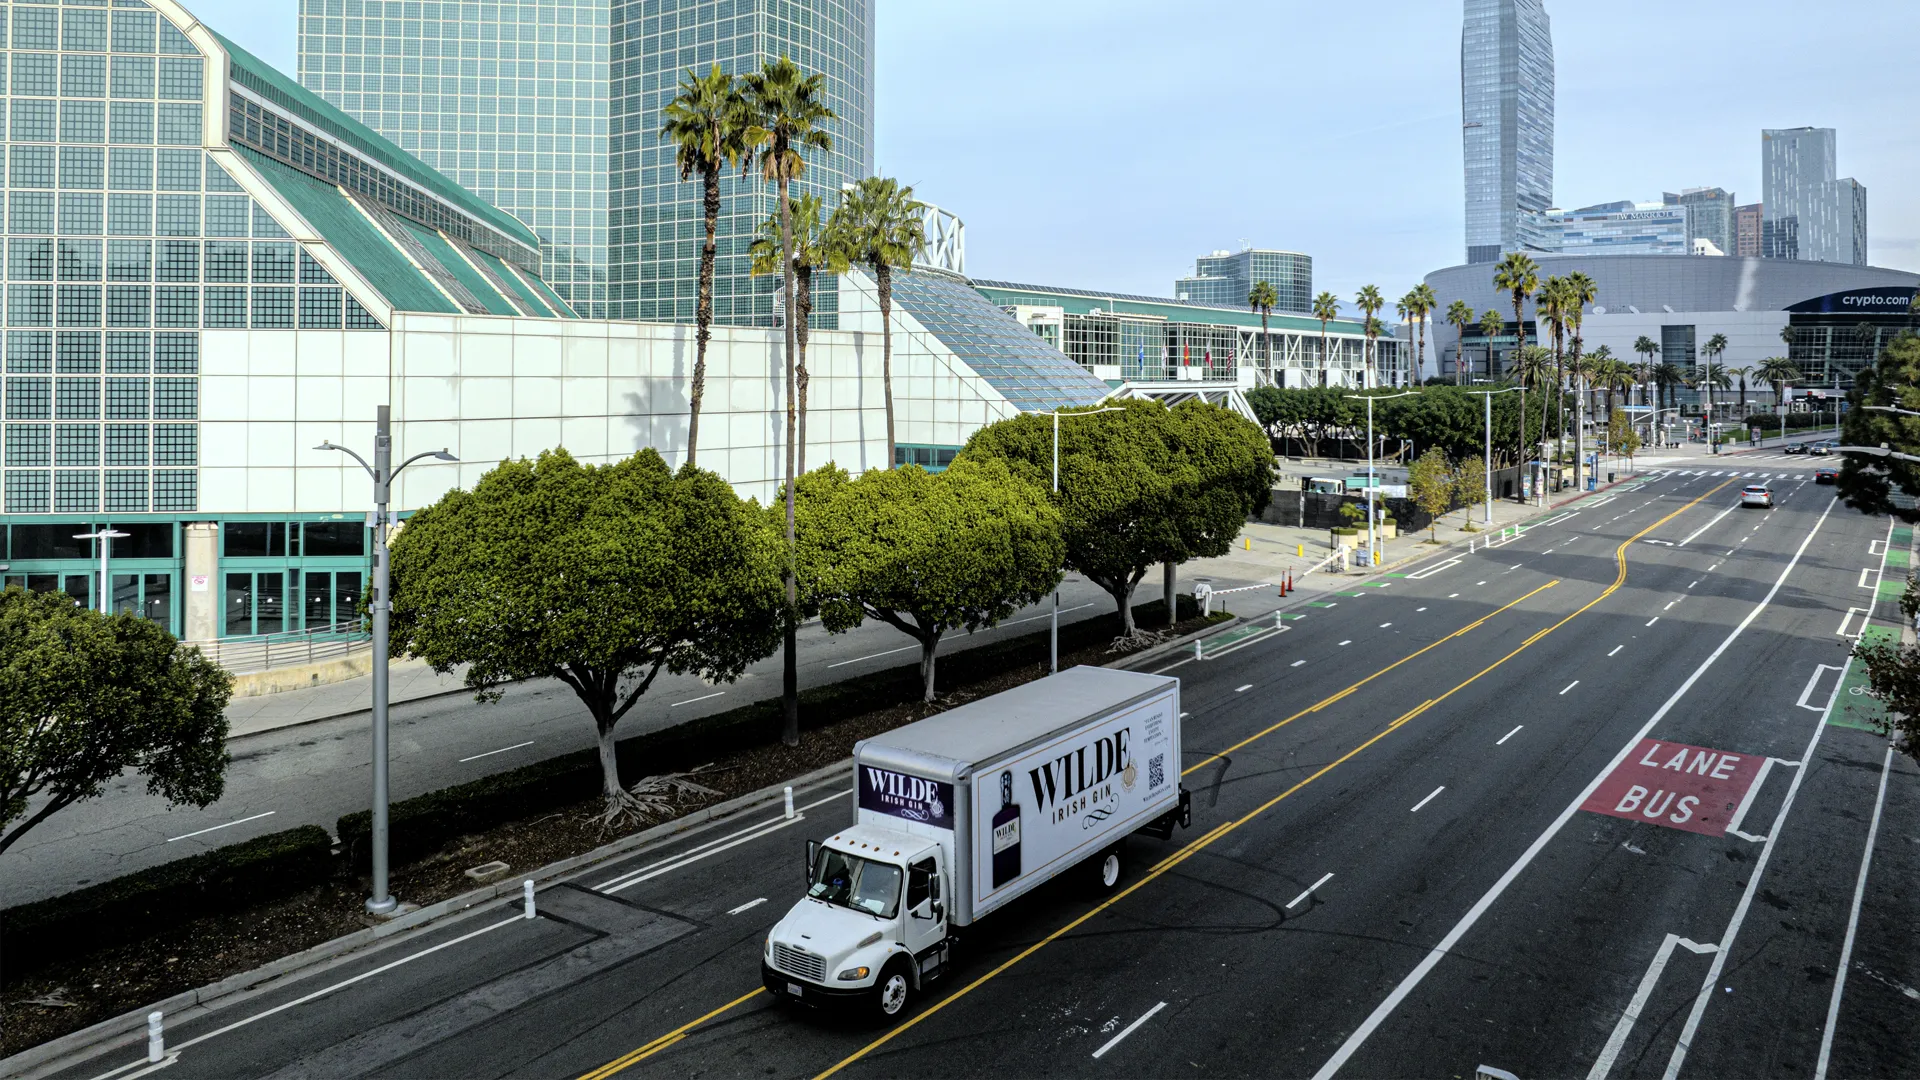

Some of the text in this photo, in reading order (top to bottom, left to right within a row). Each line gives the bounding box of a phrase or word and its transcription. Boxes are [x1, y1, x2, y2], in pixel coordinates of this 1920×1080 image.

[1630, 211, 1677, 220] MARRIOTT
[1842, 295, 1909, 306] crypto.com
[1028, 727, 1131, 814] WILDE
[1639, 743, 1741, 780] LANE
[866, 767, 939, 804] WILDE
[881, 794, 905, 806] IRISH
[908, 801, 923, 810] GIN
[1614, 784, 1700, 824] BUS
[1052, 784, 1111, 825] IRISH GIN
